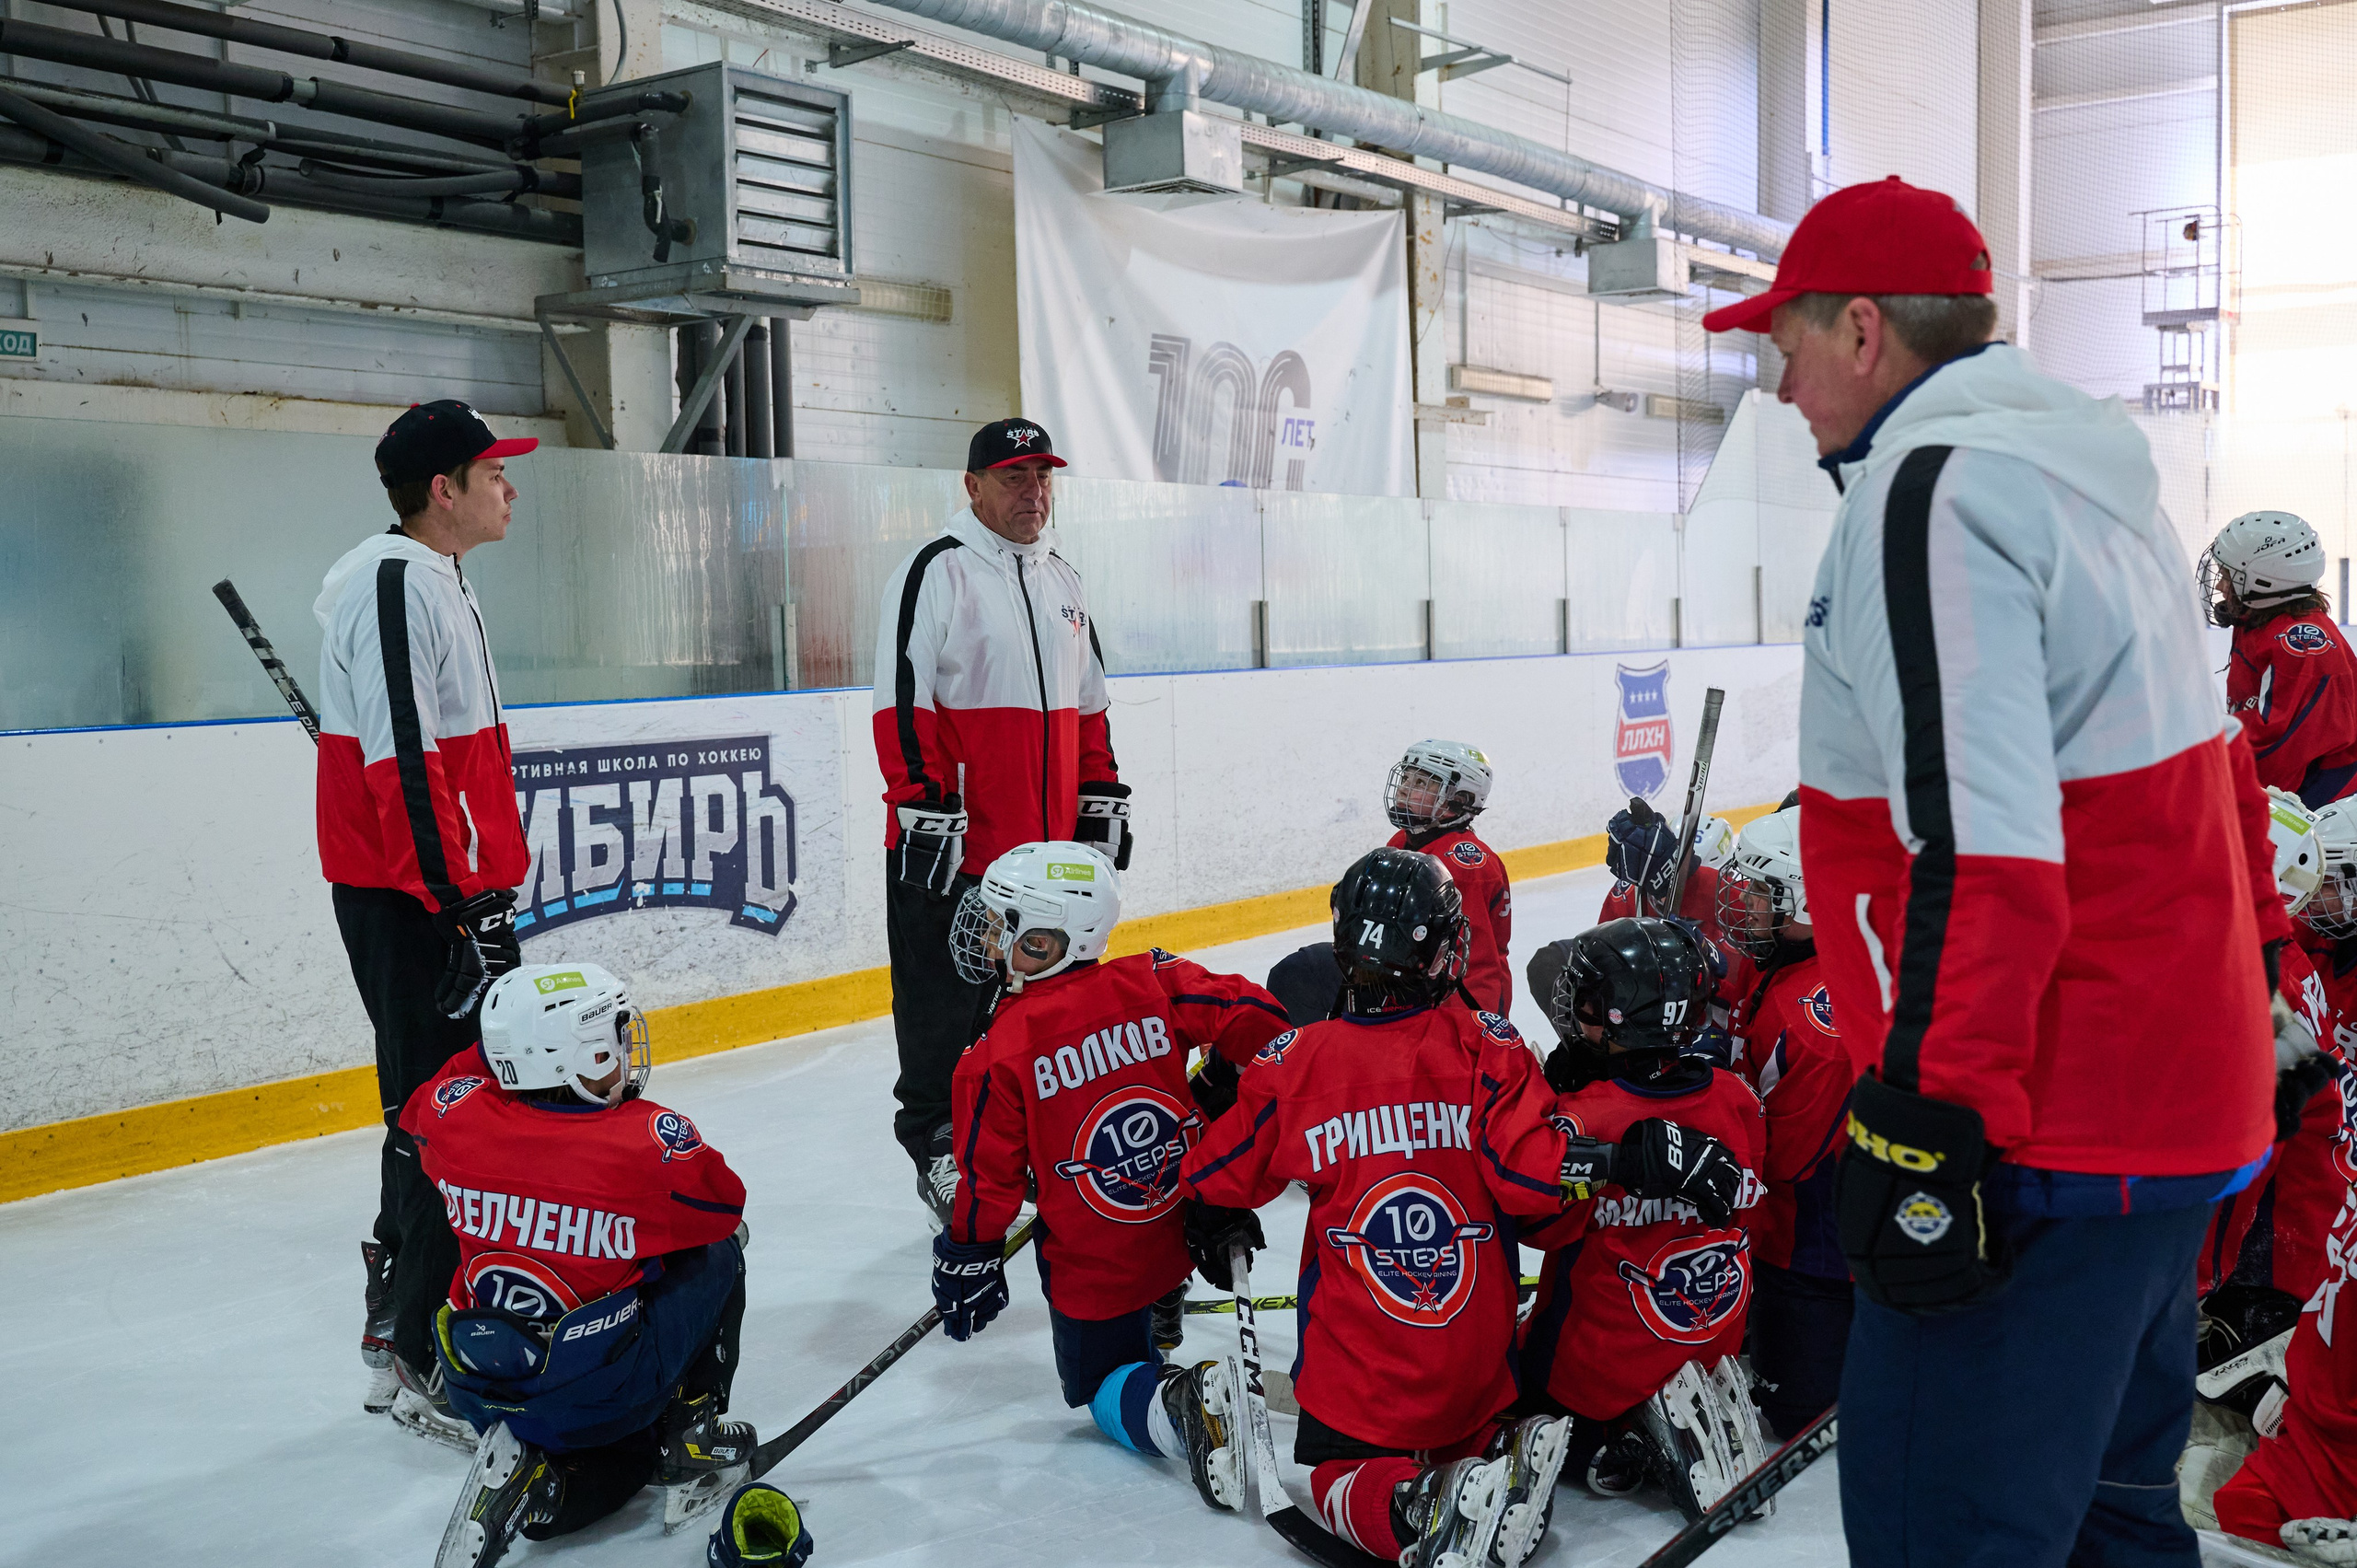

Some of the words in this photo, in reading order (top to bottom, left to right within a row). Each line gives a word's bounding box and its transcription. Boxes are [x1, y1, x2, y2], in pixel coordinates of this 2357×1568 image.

[0, 333, 31, 355] ОД
[1281, 417, 1315, 451] ЛЕТ
[2253, 537, 2286, 554] JOFA
[2297, 625, 2320, 636] 10
[1621, 725, 1666, 752] ЛЛХН
[512, 761, 587, 779] РТИВНАЯ
[598, 756, 658, 773] ШКОЛА
[668, 752, 689, 767] ПО
[698, 747, 762, 765] ХОККЕЮ
[1081, 800, 1130, 818] CC
[912, 816, 968, 832] CC
[513, 771, 790, 912] ИБИРЬ
[1458, 843, 1477, 852] 10
[1064, 866, 1092, 877] Airlines
[1358, 919, 1385, 949] 74
[556, 976, 582, 985] Airlines
[1570, 966, 1584, 979] CCM
[581, 1003, 613, 1023] BAUER
[1662, 999, 1689, 1026] 97
[1033, 1016, 1171, 1100] ВОЛКОВ
[494, 1060, 518, 1086] 20
[659, 1116, 679, 1136] 10
[1102, 1110, 1159, 1156] 10
[1305, 1102, 1472, 1173] ГРИЩЕНК
[1101, 1139, 1184, 1187] STEPS
[1108, 1183, 1128, 1195] ELITE
[1128, 1172, 1155, 1187] HOCKEY
[1385, 1203, 1436, 1244] 10
[933, 1252, 1002, 1276] AUER
[1375, 1245, 1457, 1268] STEPS
[493, 1274, 548, 1318] 10
[1683, 1296, 1713, 1306] HOCKEY
[830, 1307, 941, 1404] VAPOR
[1236, 1295, 1265, 1398] CCM
[1708, 1419, 1839, 1535] SHER-W
